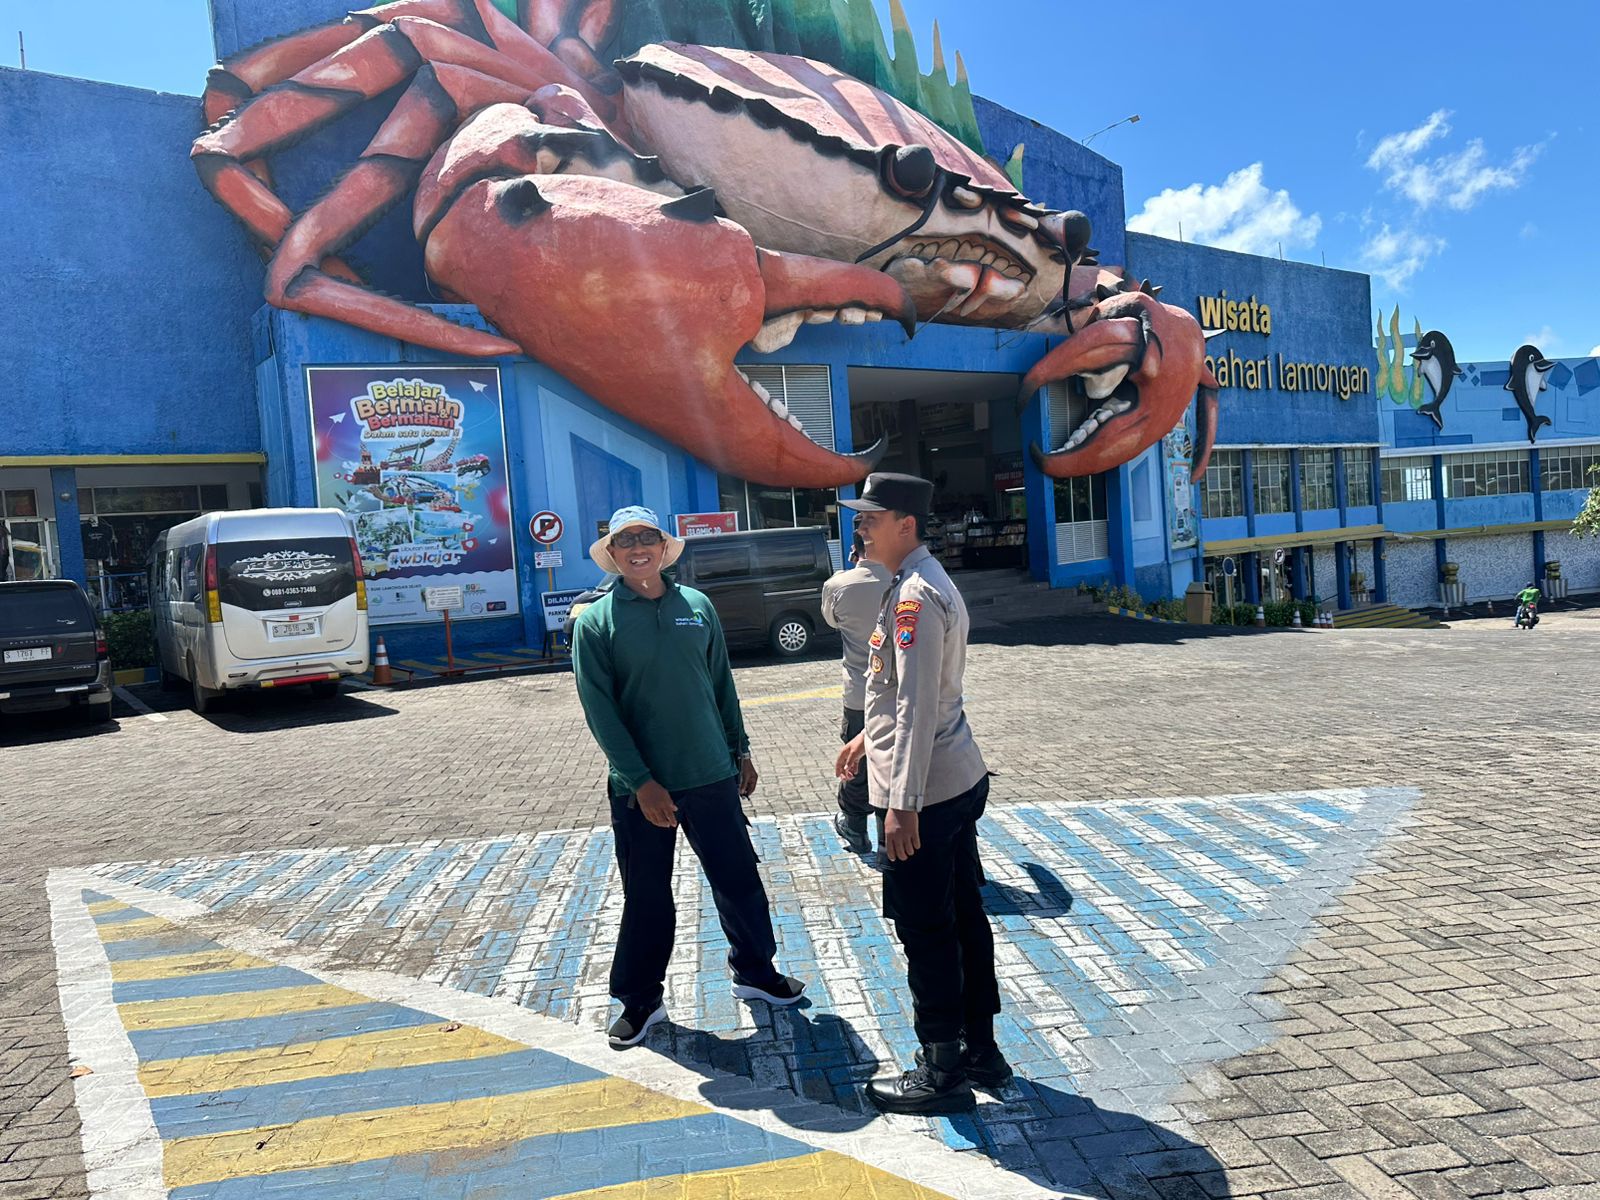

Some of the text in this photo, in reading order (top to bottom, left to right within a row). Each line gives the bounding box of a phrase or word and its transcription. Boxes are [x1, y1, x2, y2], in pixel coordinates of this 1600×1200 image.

[1200, 289, 1271, 334] wisata
[1278, 352, 1370, 400] lamongan
[371, 382, 441, 400] Belajar
[355, 396, 460, 419] Bermain
[397, 430, 420, 438] satu
[421, 429, 450, 437] lokasi
[5, 651, 11, 659] S
